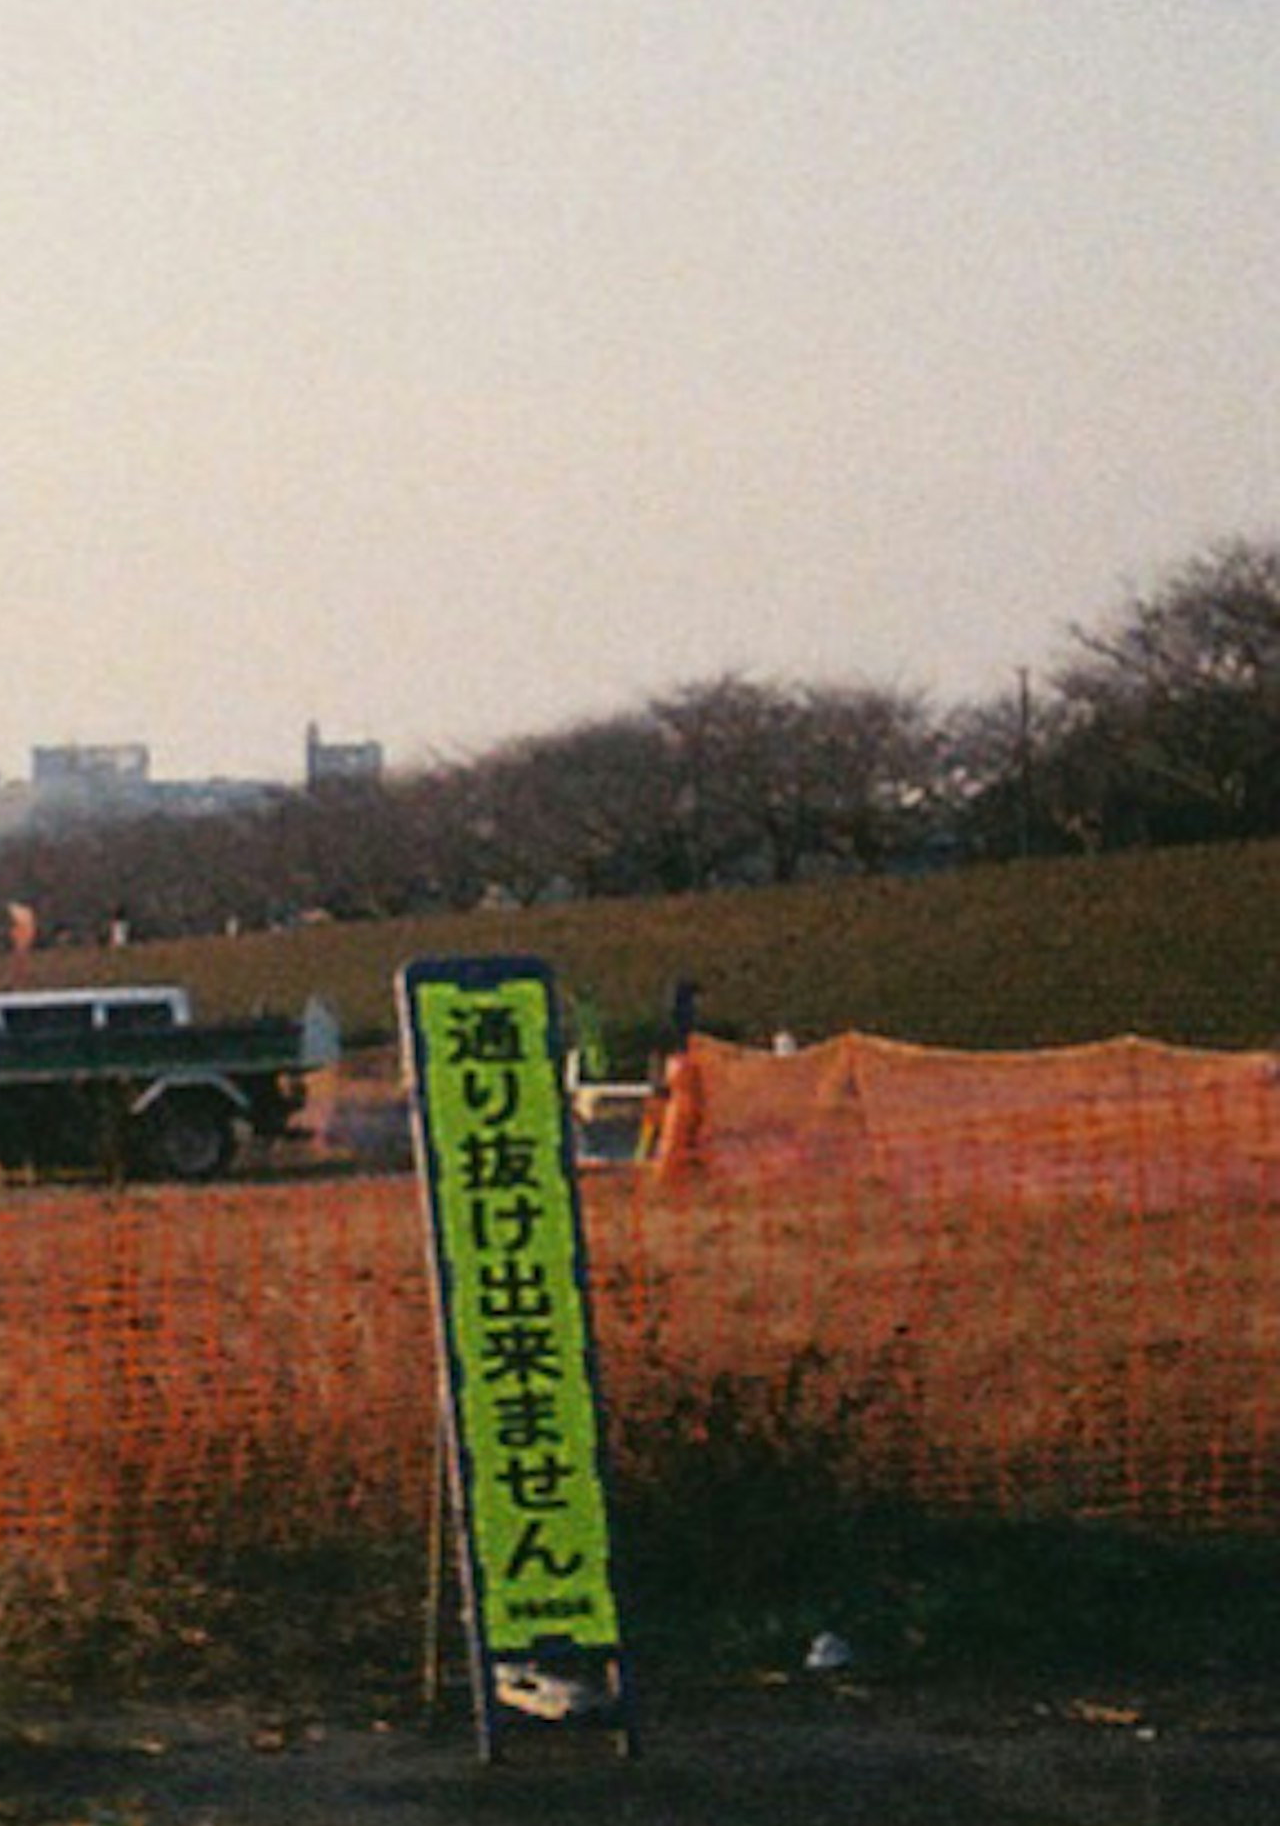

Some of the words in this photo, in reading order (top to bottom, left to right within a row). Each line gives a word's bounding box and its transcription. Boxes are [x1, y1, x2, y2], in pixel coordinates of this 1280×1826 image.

[447, 1006, 582, 1579] 通り抜け出来ません
